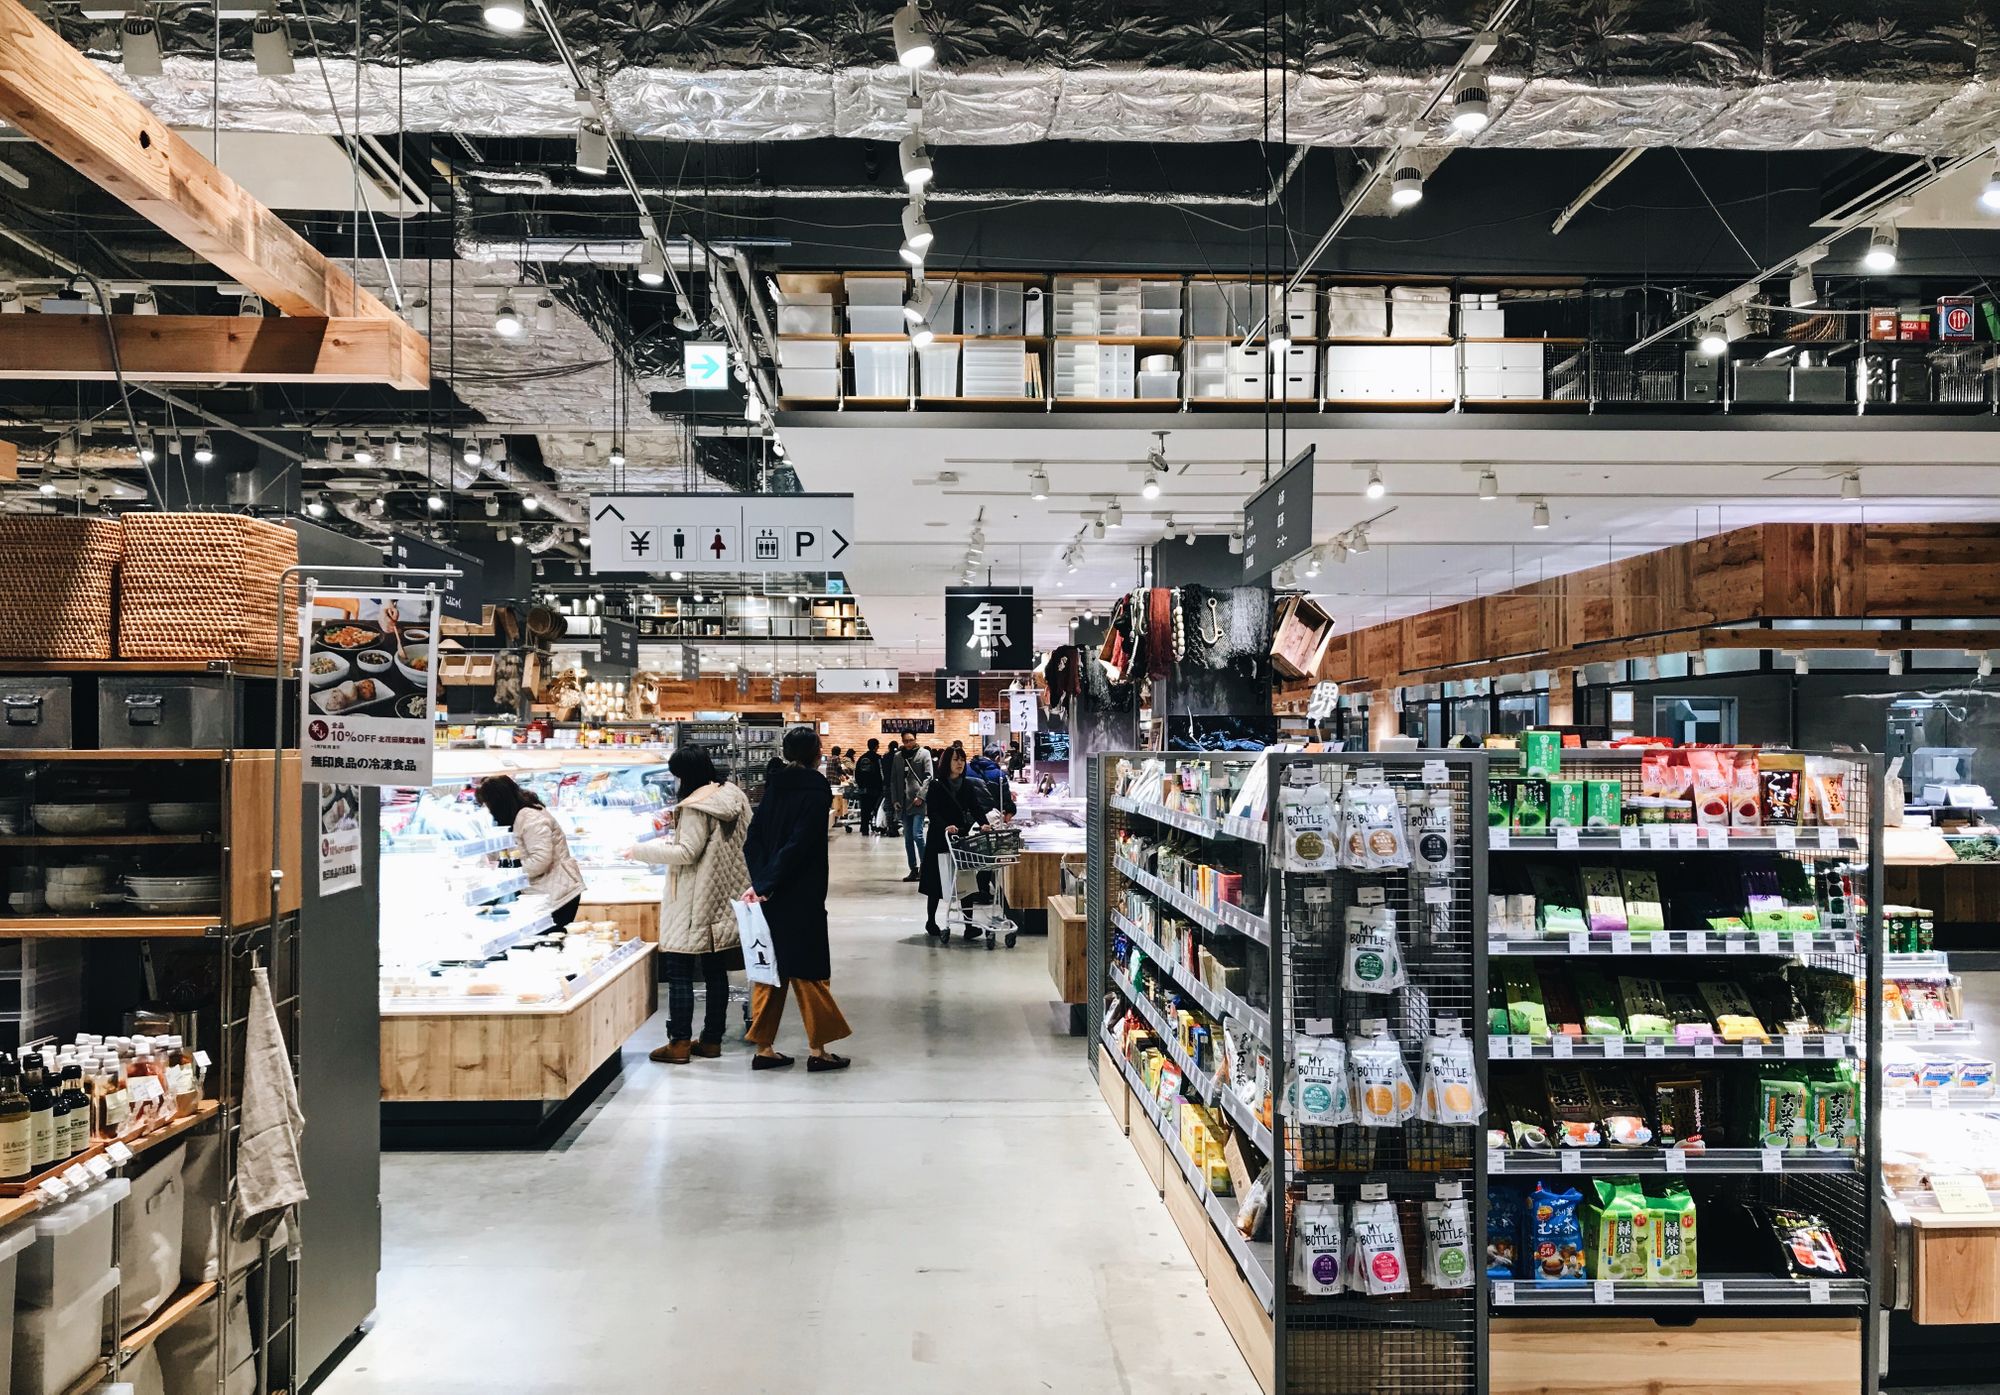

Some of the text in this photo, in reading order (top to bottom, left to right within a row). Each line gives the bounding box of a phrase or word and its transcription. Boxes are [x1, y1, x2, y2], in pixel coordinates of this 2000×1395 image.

[795, 531, 815, 557] P
[966, 601, 1013, 649] 魚
[980, 649, 999, 658] fish
[946, 675, 969, 699] 肉
[330, 730, 377, 743] 10%OFF
[310, 755, 417, 771] 無印良品の冷凍食品
[1296, 806, 1311, 815] MY
[1420, 807, 1434, 816] MY
[1287, 814, 1323, 825] BOTTLE
[1411, 816, 1447, 826] BOTTLE
[1360, 924, 1376, 934] MY
[1350, 933, 1386, 945] BOTTLE
[1308, 1056, 1324, 1066] MY
[1441, 1057, 1455, 1067] MY
[1298, 1065, 1334, 1077] BOTTLE
[1434, 1066, 1467, 1077] BOTTLE
[1780, 1091, 1796, 1139] 玄米茶
[1829, 1092, 1845, 1139] 玄米茶
[1313, 1225, 1327, 1235] MY
[1367, 1224, 1381, 1234] MY
[1438, 1219, 1452, 1230] MY
[1537, 1217, 1578, 1235] むぎ茶
[1305, 1235, 1337, 1245] BOTTLE
[1360, 1233, 1394, 1245] BOTTLE
[1430, 1228, 1464, 1241] BOTTLE
[1617, 1220, 1632, 1255] 緑茶
[1665, 1221, 1680, 1256] 緑茶
